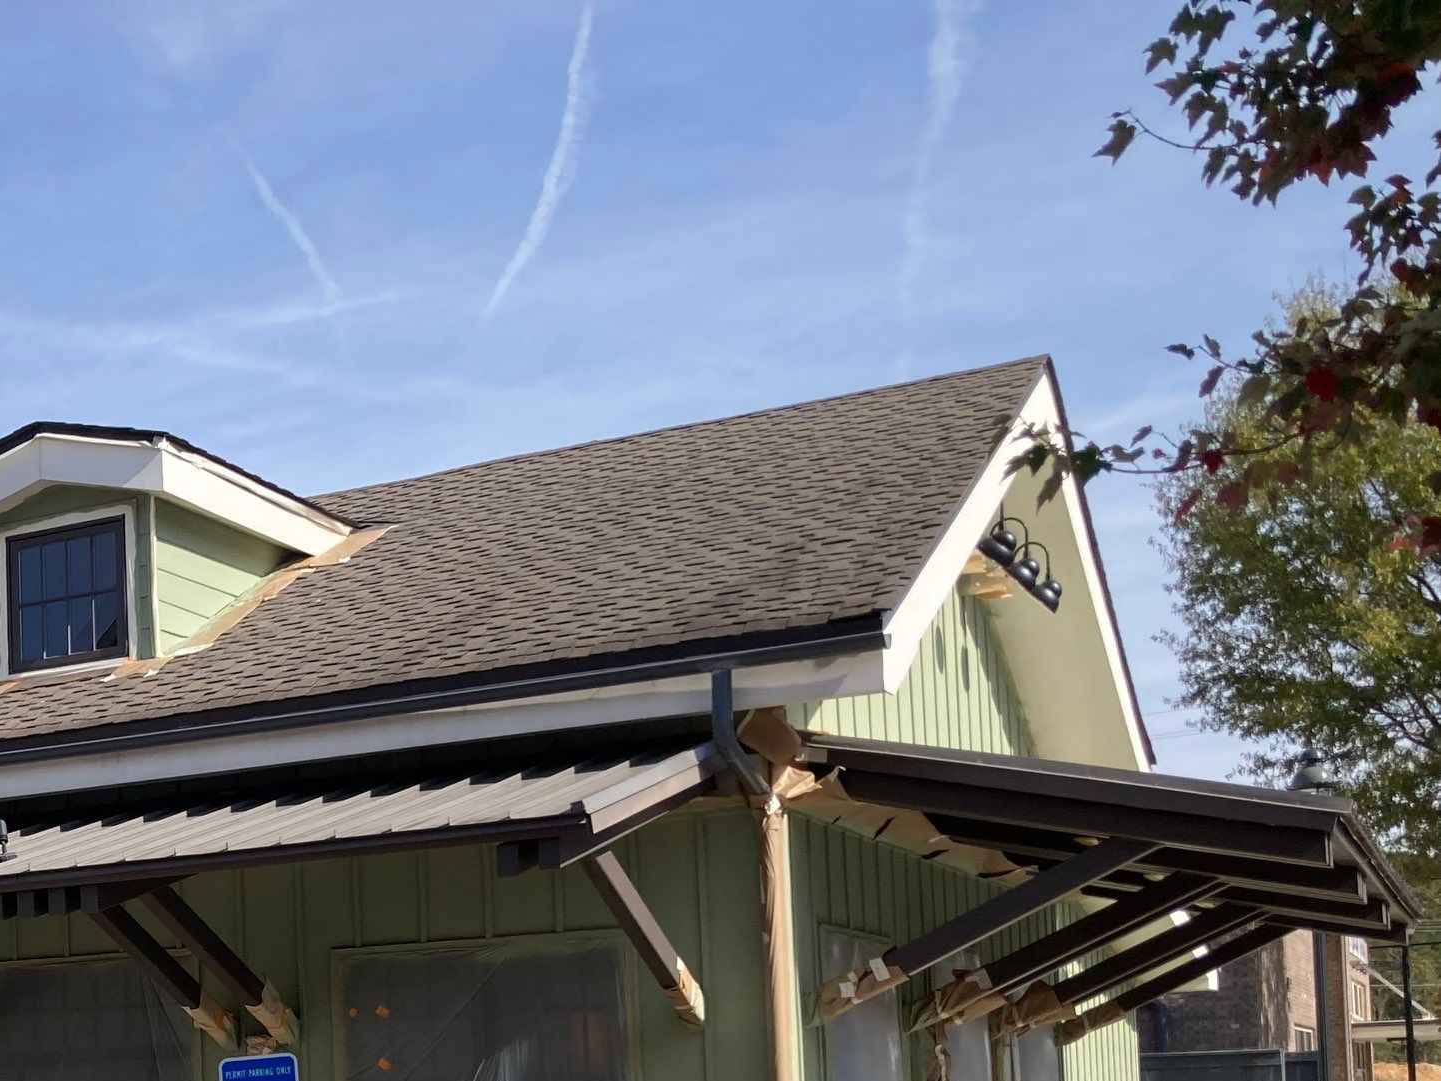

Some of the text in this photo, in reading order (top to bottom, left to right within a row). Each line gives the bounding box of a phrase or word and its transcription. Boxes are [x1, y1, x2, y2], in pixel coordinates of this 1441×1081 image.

[225, 1066, 291, 1079] PERMIT PARKING ONLY
